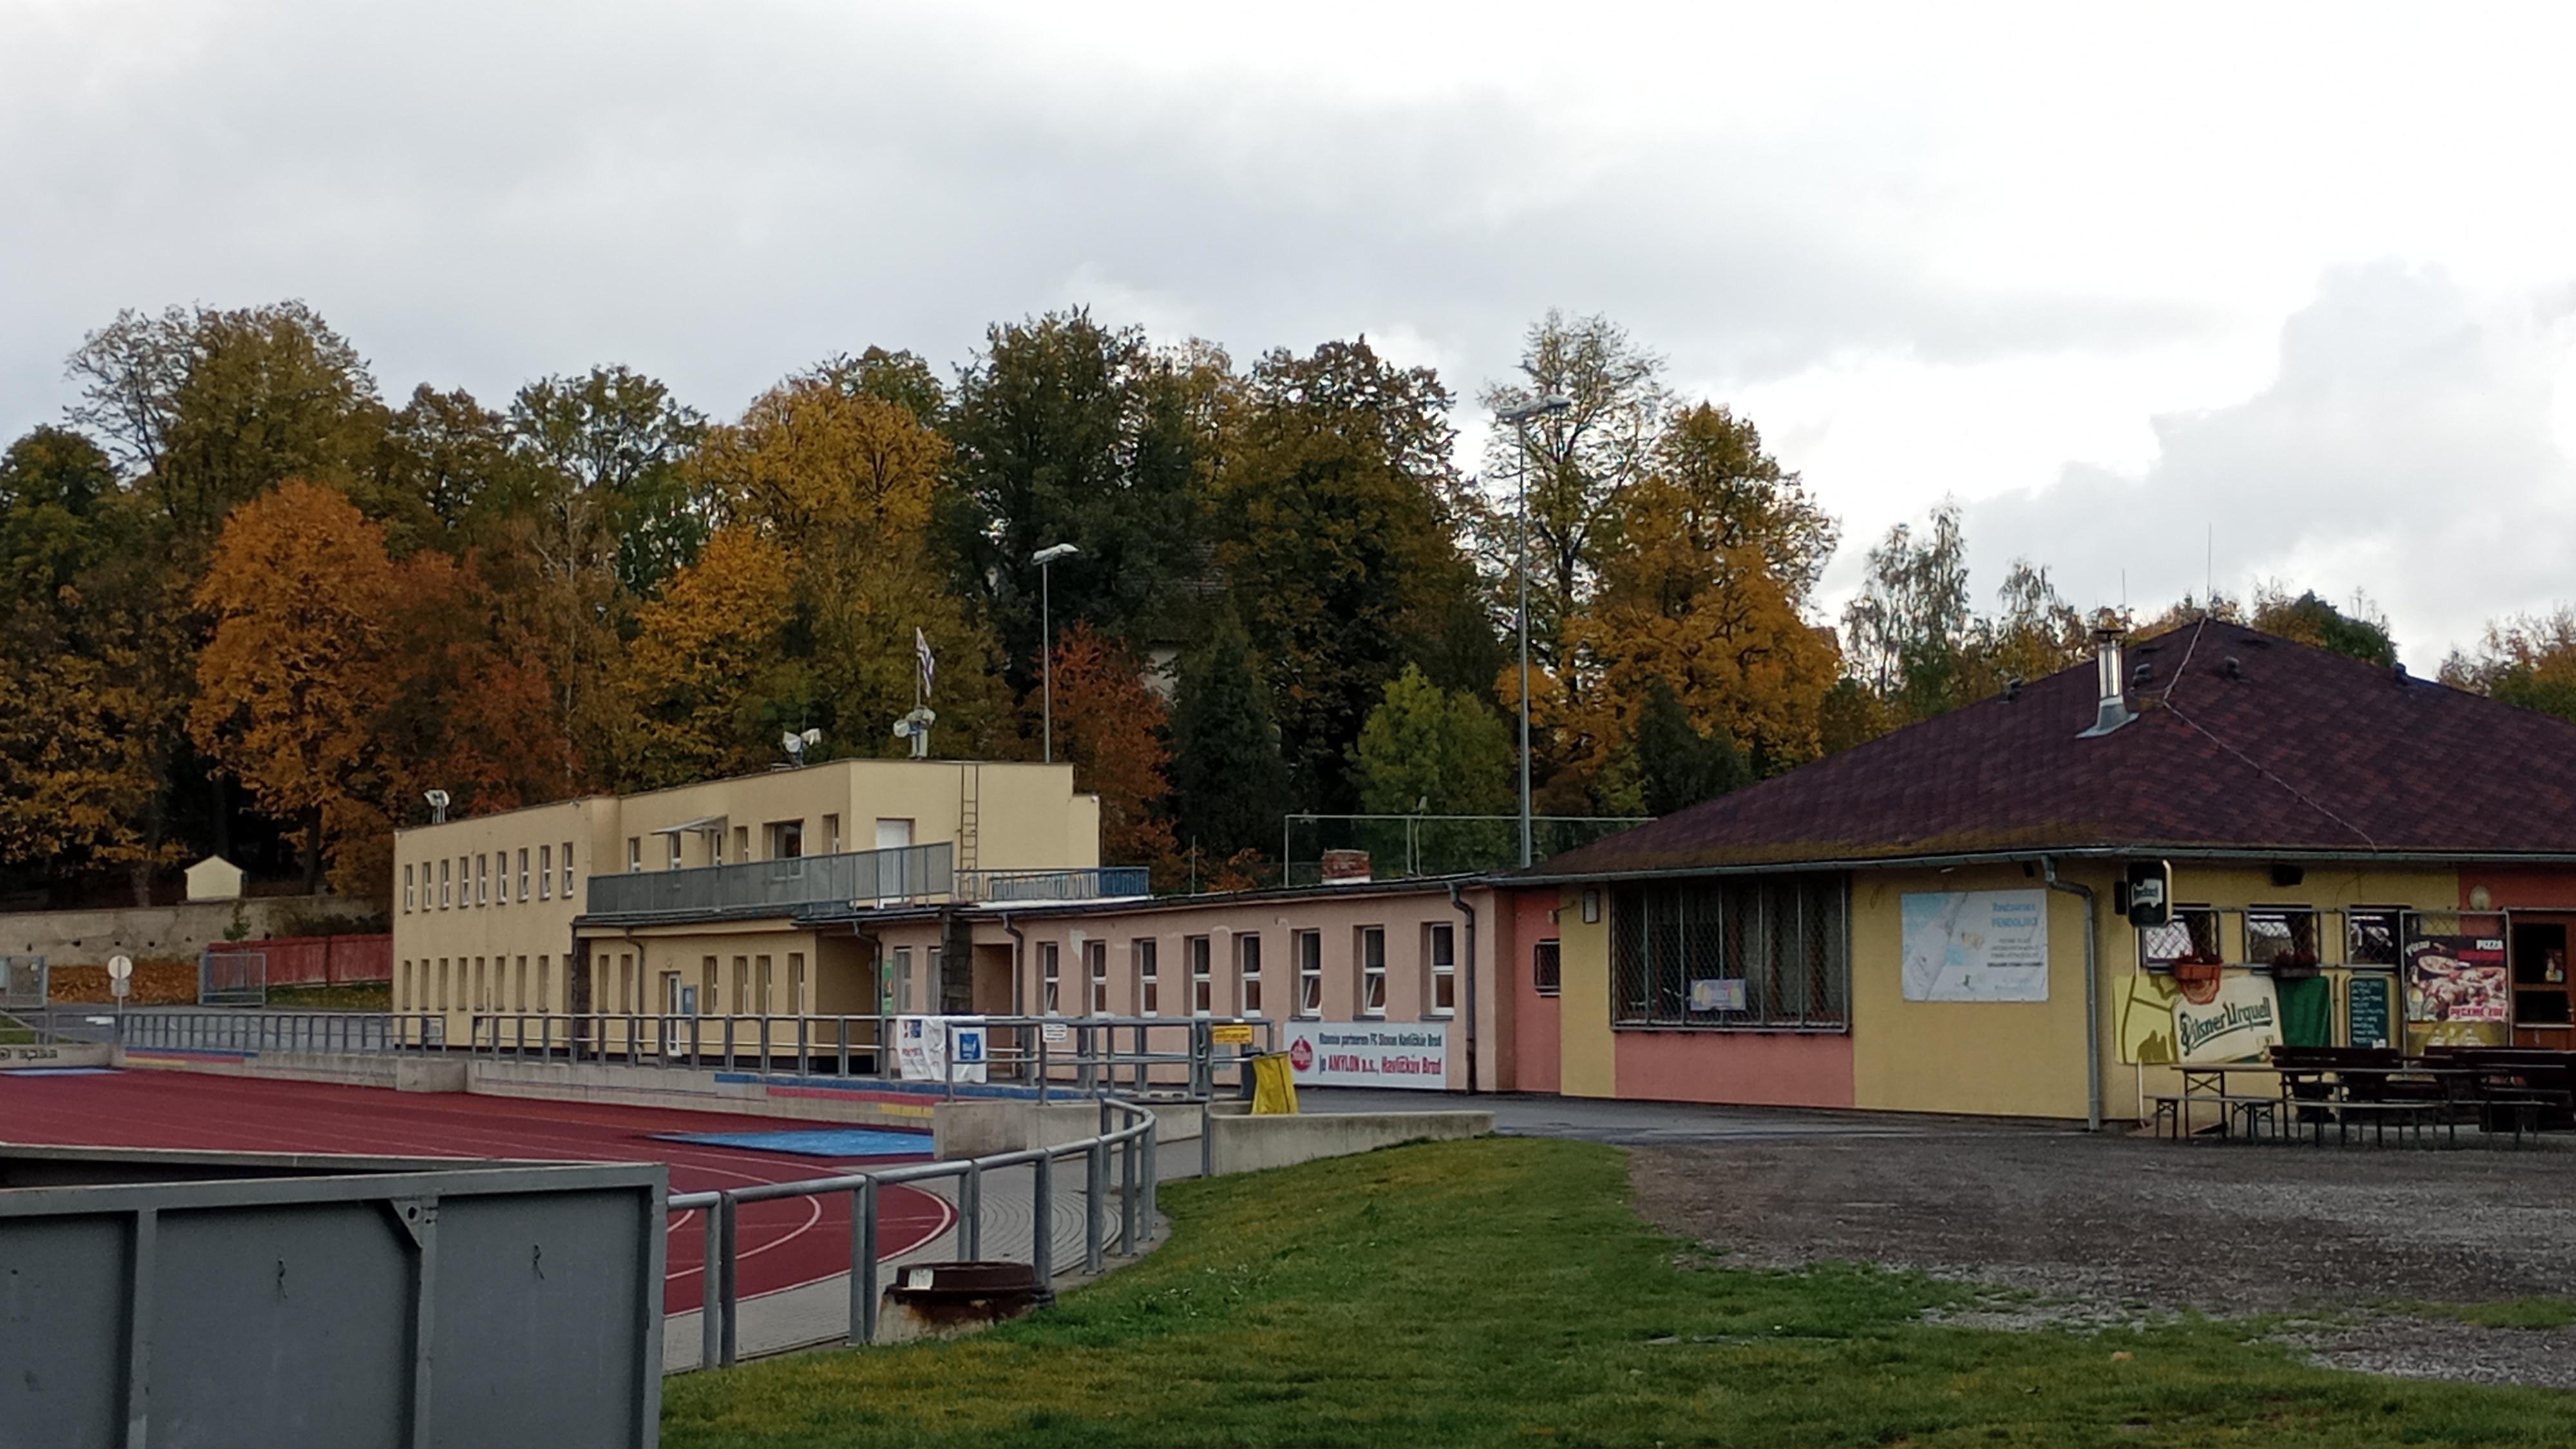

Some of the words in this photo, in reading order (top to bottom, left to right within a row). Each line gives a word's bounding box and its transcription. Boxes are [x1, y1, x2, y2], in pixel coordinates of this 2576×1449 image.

[2179, 1010, 2225, 1056] Pilsner
[2222, 996, 2271, 1032] Urquell
[1428, 1033, 1442, 1047] Brod
[1319, 1054, 1326, 1074] je
[1422, 1056, 1441, 1075] Brod
